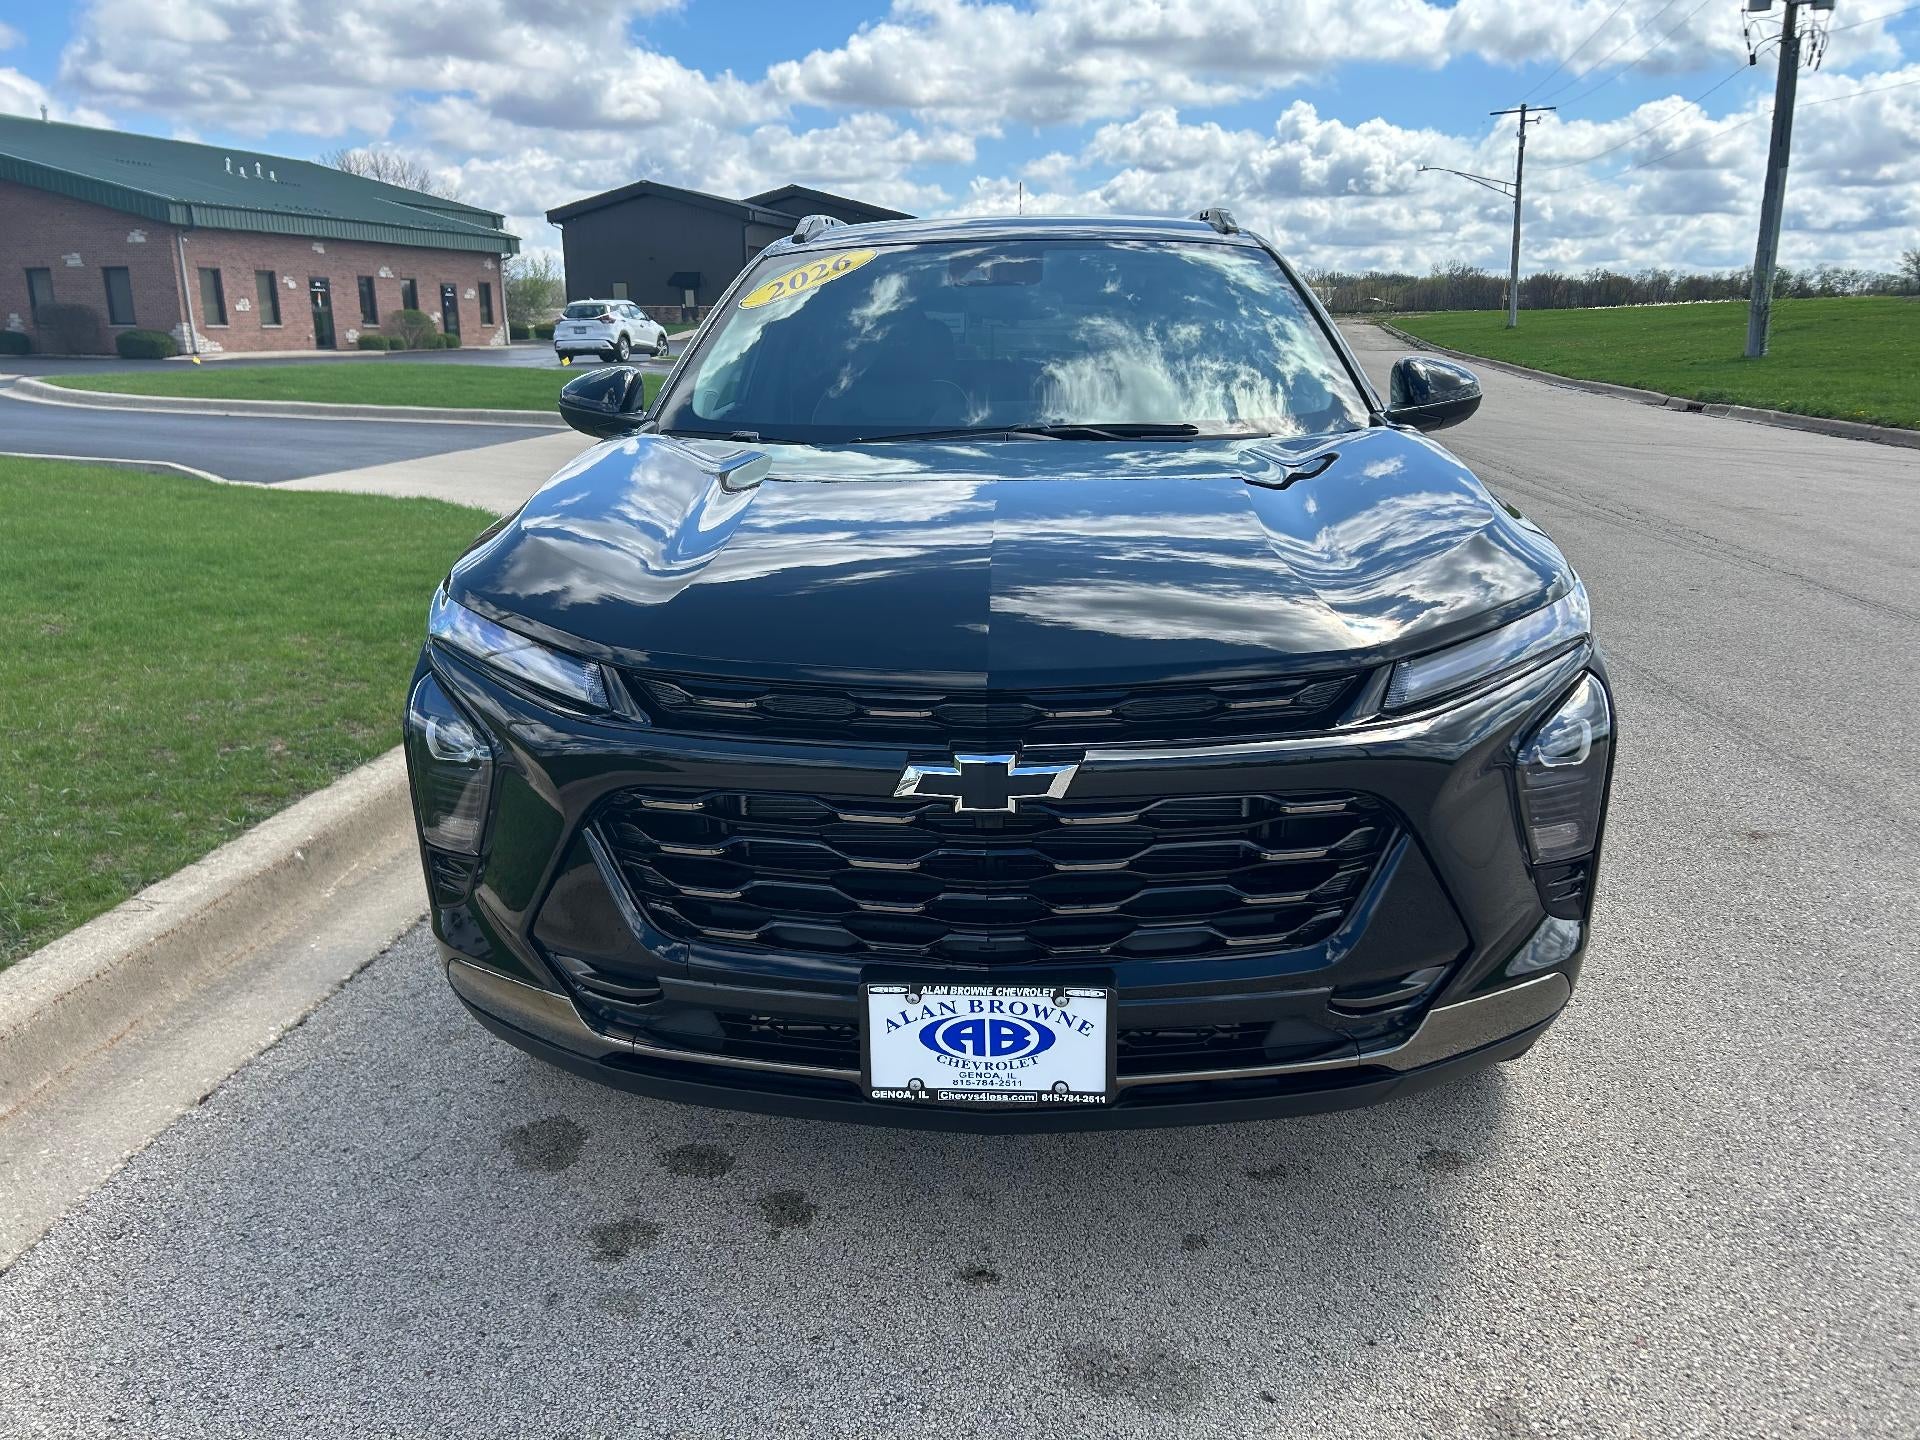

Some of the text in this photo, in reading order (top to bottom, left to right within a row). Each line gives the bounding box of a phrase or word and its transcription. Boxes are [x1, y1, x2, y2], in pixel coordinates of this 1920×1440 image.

[767, 255, 853, 301] 2026
[920, 985, 948, 995] ALAN
[950, 986, 993, 996] BROWNE
[996, 987, 1056, 997] CHEVROLET
[886, 999, 1095, 1037] ALAN BROWNE
[942, 1018, 1031, 1056] AB
[936, 1054, 1039, 1071] CHEVROLET
[959, 1072, 1003, 1080] GENOA,
[871, 1090, 930, 1100] GENOA, IL
[940, 1091, 1035, 1102] Chevys4less.com
[1041, 1094, 1106, 1103] 815-784-2511
